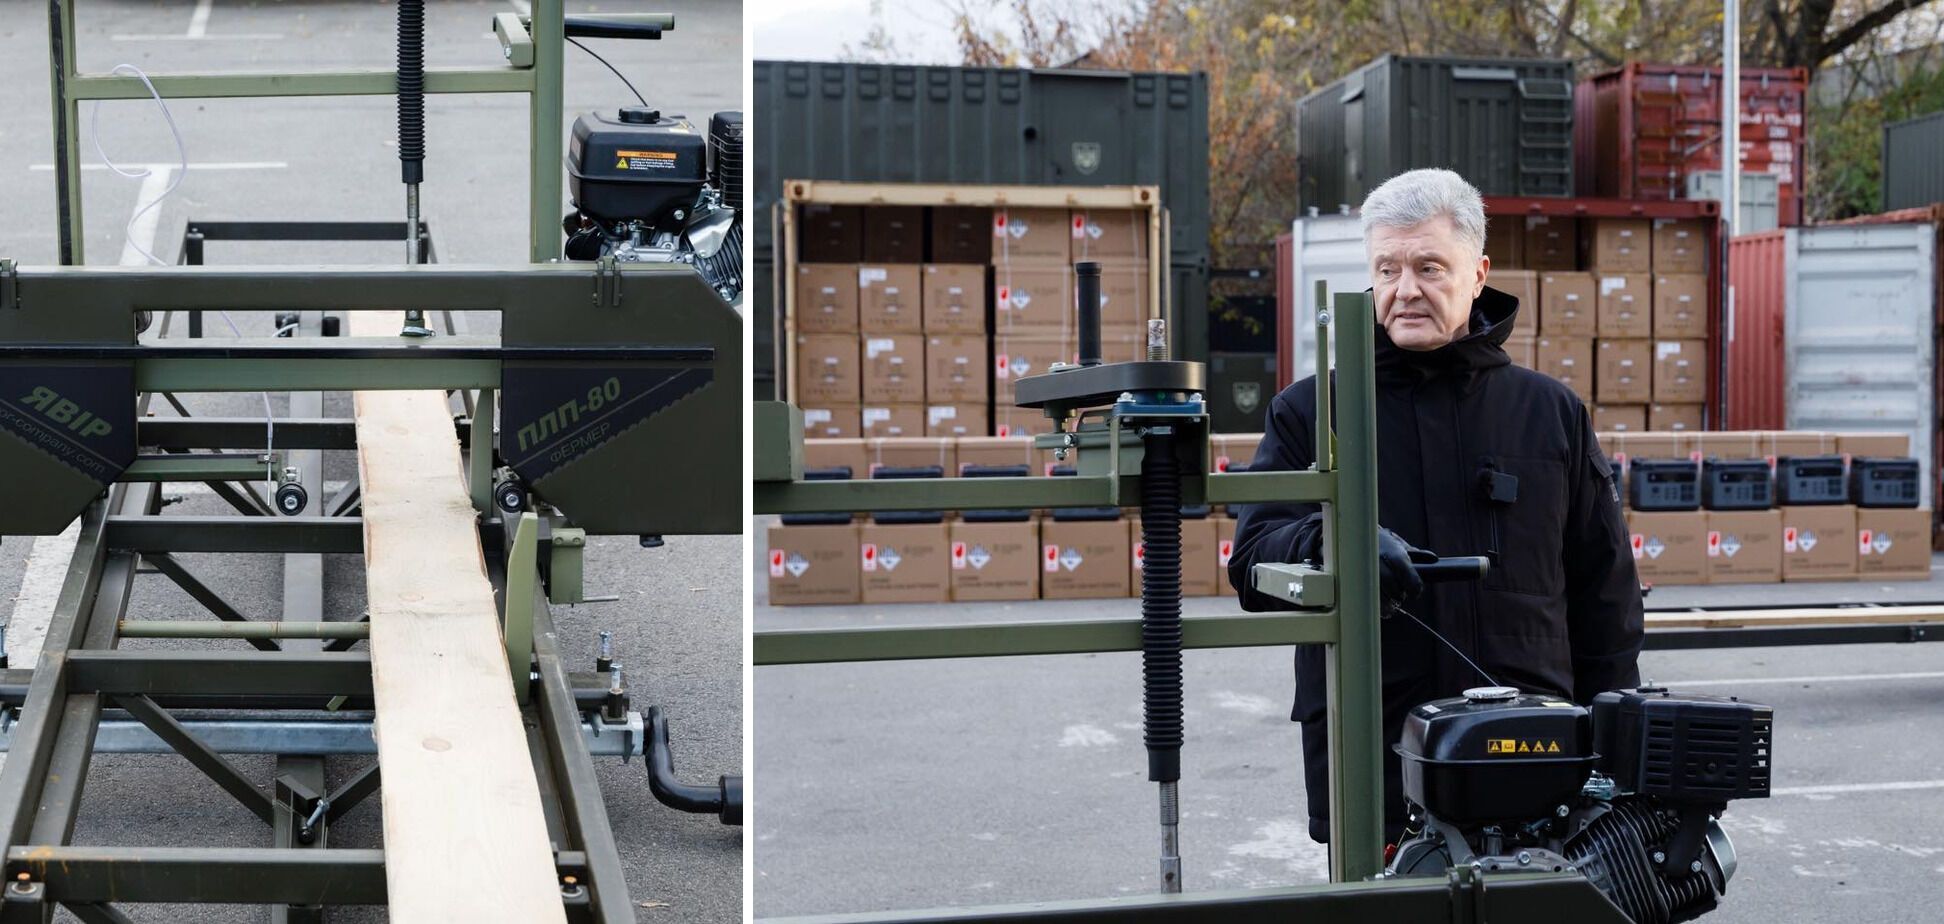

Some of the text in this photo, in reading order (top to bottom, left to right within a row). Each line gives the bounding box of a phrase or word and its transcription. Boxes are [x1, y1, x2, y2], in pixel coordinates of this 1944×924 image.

[19, 386, 113, 437] ЯВІР
[517, 376, 621, 452] ПЛП-80
[550, 422, 610, 462] ФЕРМЕР
